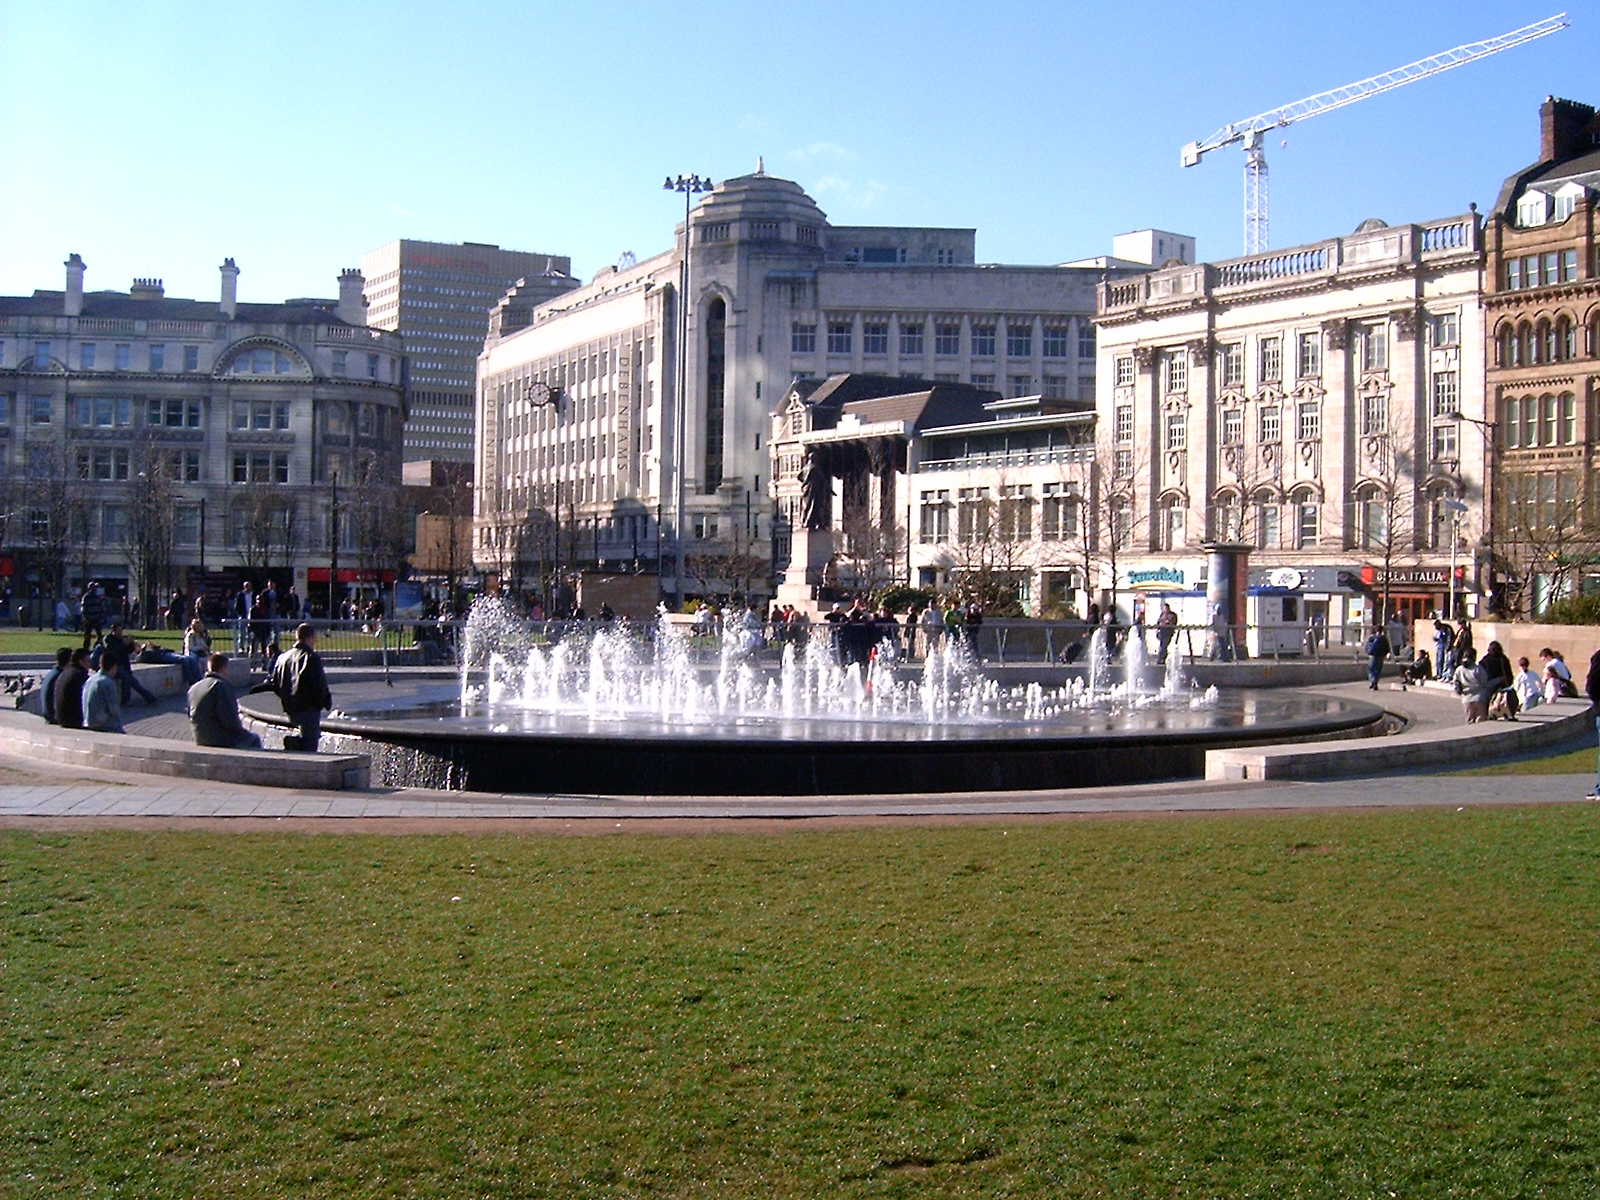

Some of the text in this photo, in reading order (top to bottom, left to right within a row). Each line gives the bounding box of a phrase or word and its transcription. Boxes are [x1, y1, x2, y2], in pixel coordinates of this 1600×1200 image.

[485, 399, 496, 492] DEBENHAMS
[617, 357, 630, 471] DEBENHAMS
[1410, 571, 1443, 582] ITALIA
